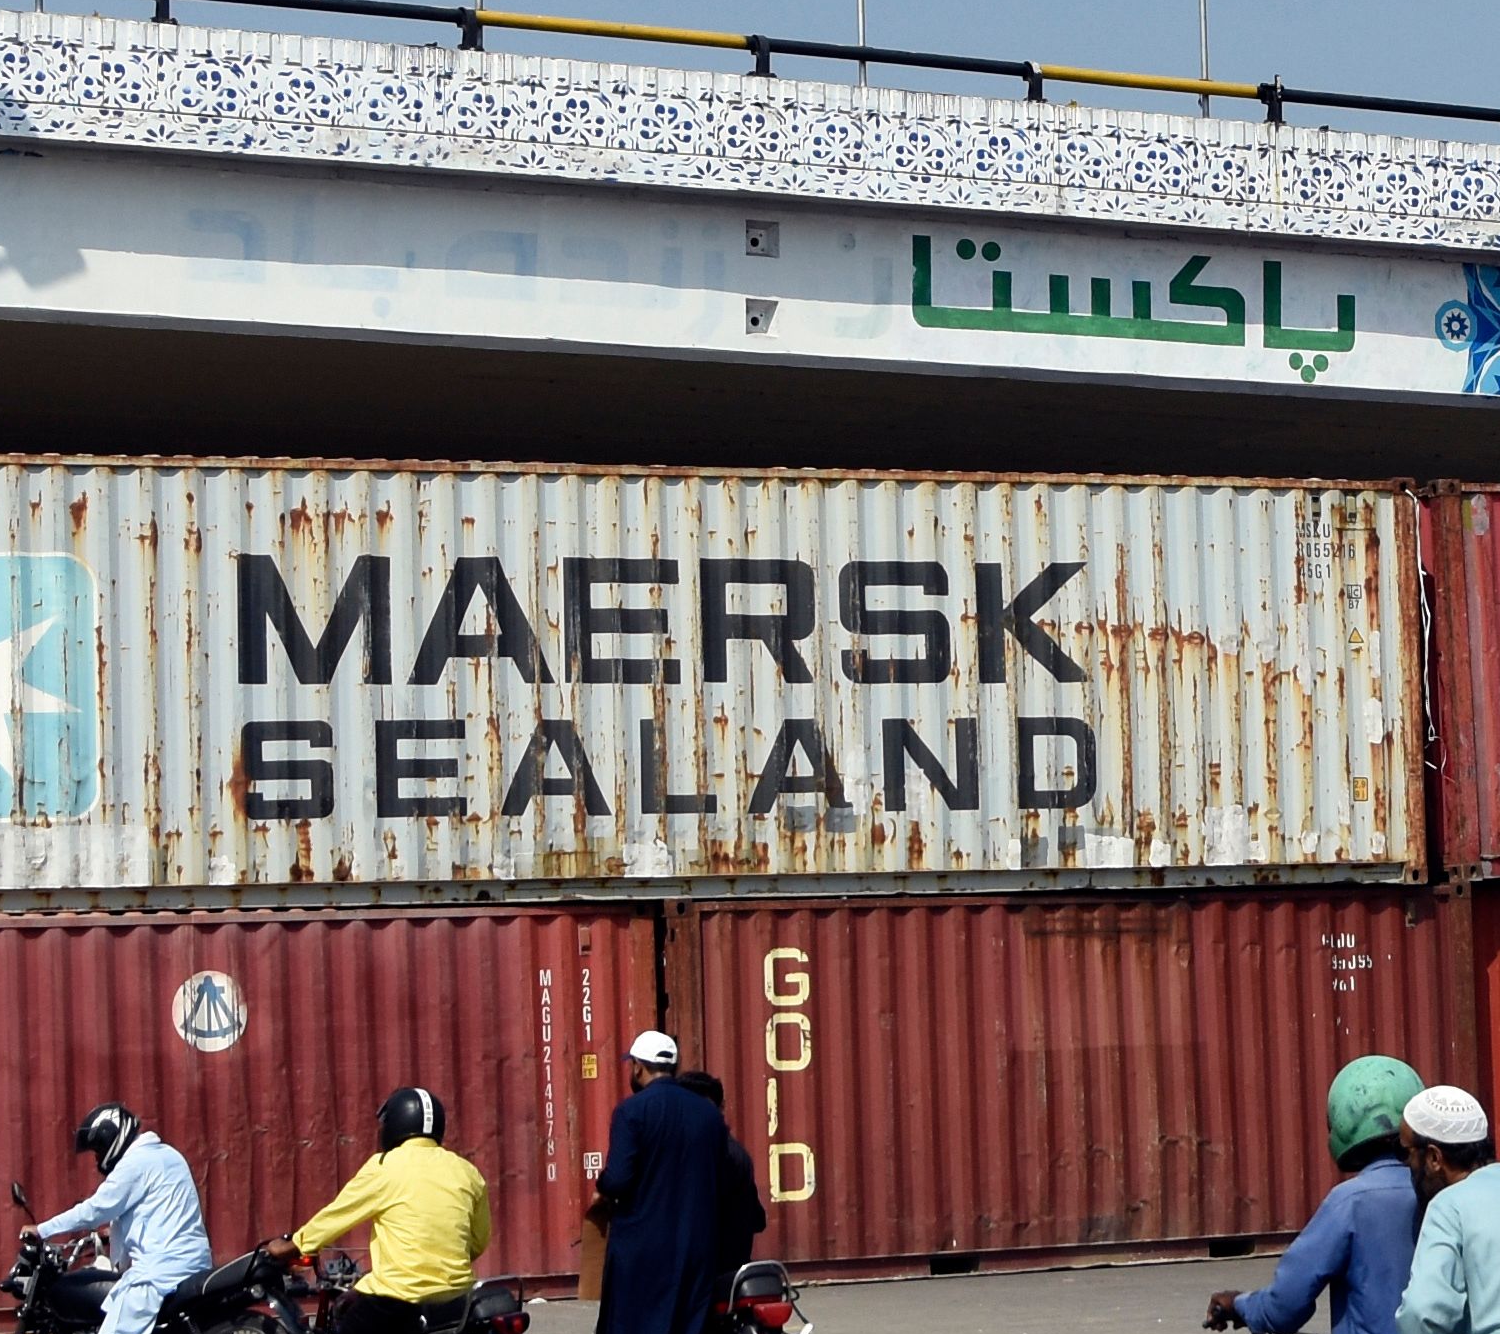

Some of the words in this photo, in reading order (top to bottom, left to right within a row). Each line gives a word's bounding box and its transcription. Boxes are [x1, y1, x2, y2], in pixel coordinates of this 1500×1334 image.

[236, 554, 1089, 685] MAERSK
[243, 717, 1098, 821] SEALAND
[581, 968, 592, 1042] 22G1
